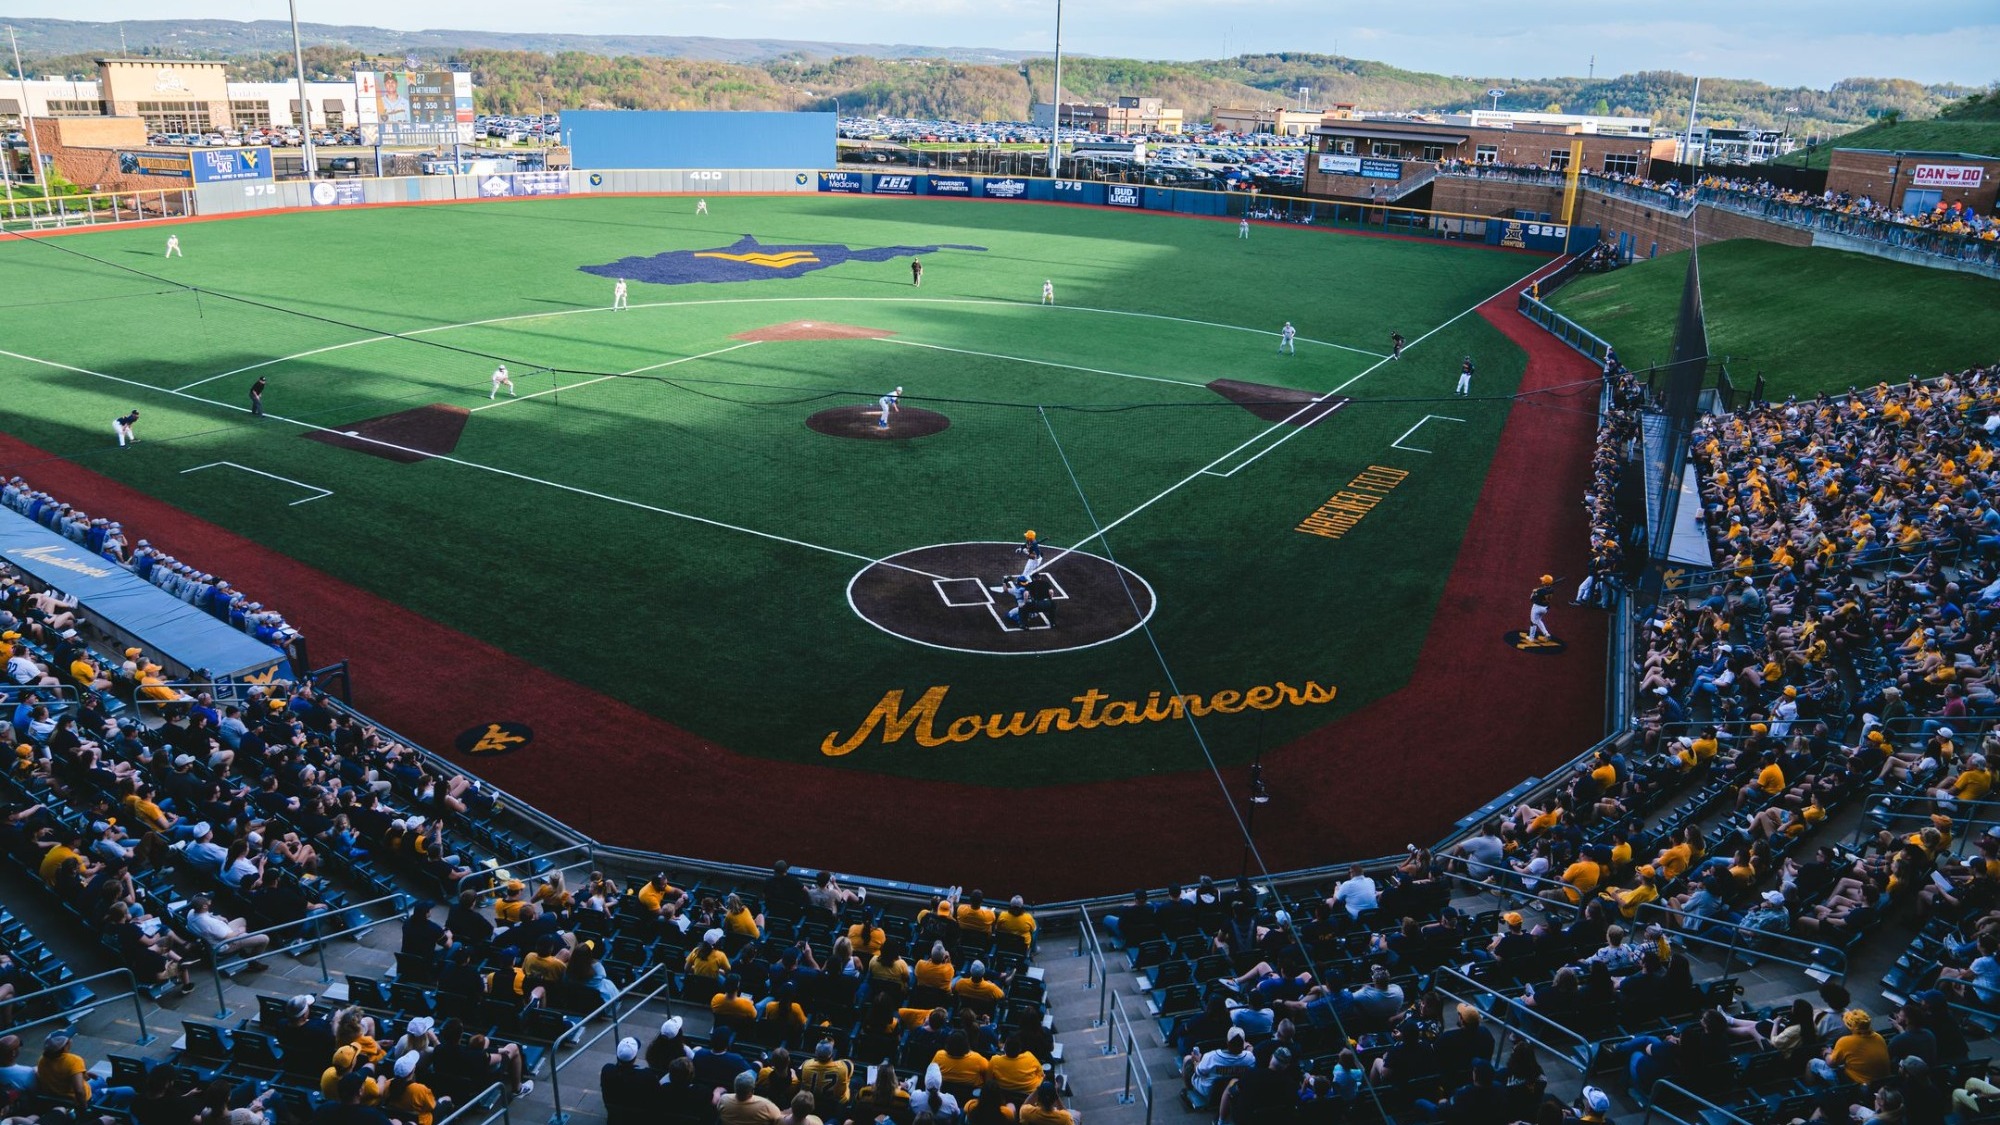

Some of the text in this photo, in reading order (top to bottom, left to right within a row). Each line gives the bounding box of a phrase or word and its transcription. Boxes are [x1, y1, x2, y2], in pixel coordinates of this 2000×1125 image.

[207, 151, 220, 165] FLY
[217, 162, 232, 173] CKB
[690, 171, 722, 180] 400
[1916, 168, 1981, 180] CAN DO
[829, 180, 860, 189] Medicine
[878, 176, 911, 189] CEC
[1055, 180, 1082, 191] 375
[244, 185, 276, 196] 375
[1114, 188, 1133, 196] BUD
[1110, 194, 1137, 204] LIGHT
[1528, 225, 1567, 238] 325
[1294, 465, 1410, 539] WAGENER FIELD
[821, 681, 1337, 757] Mountaineers
